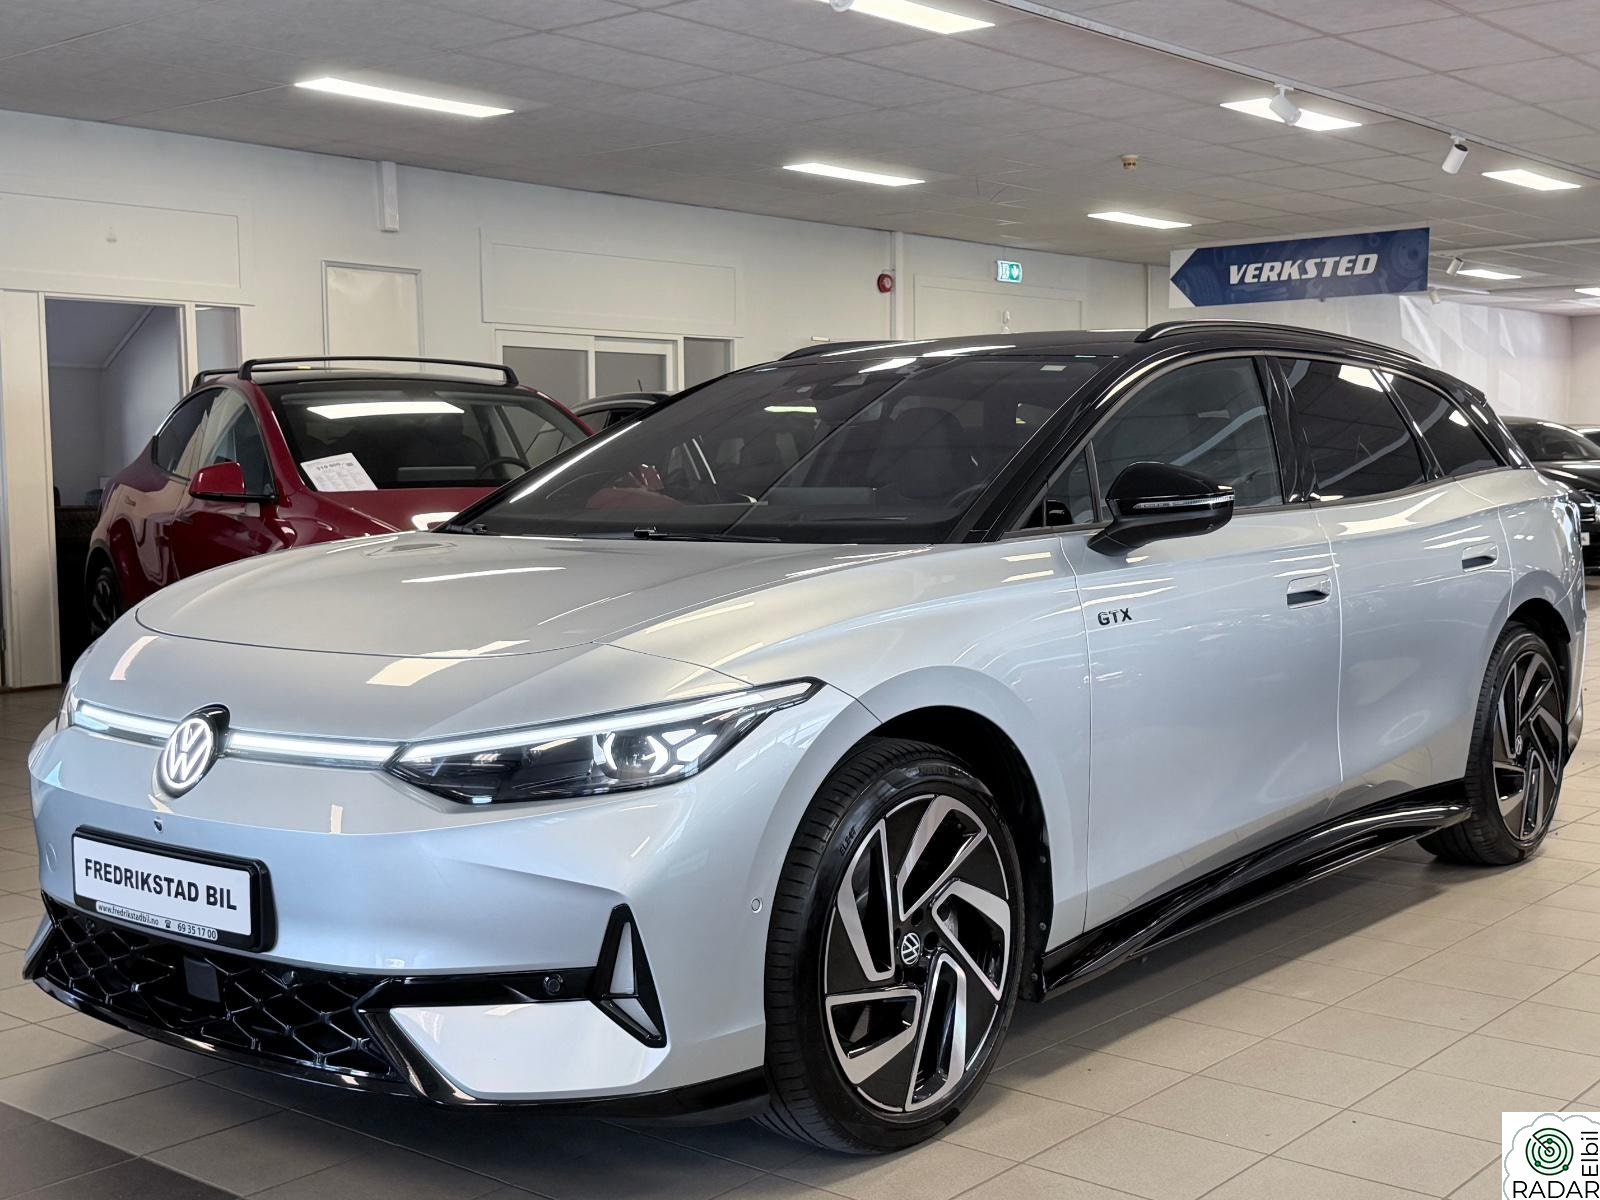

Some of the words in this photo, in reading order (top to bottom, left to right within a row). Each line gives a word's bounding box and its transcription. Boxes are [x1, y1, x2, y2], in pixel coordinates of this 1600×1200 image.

[1229, 253, 1379, 285] VERKSTED
[1097, 607, 1132, 626] GTX
[163, 718, 213, 788] VW
[84, 858, 199, 902] FREDRIKSTAD
[206, 885, 237, 911] BIL
[98, 902, 159, 926] www.fredrikstadbil.no
[177, 923, 186, 932] 69
[187, 925, 196, 935] 35
[197, 928, 206, 937] 17
[207, 930, 217, 940] 00
